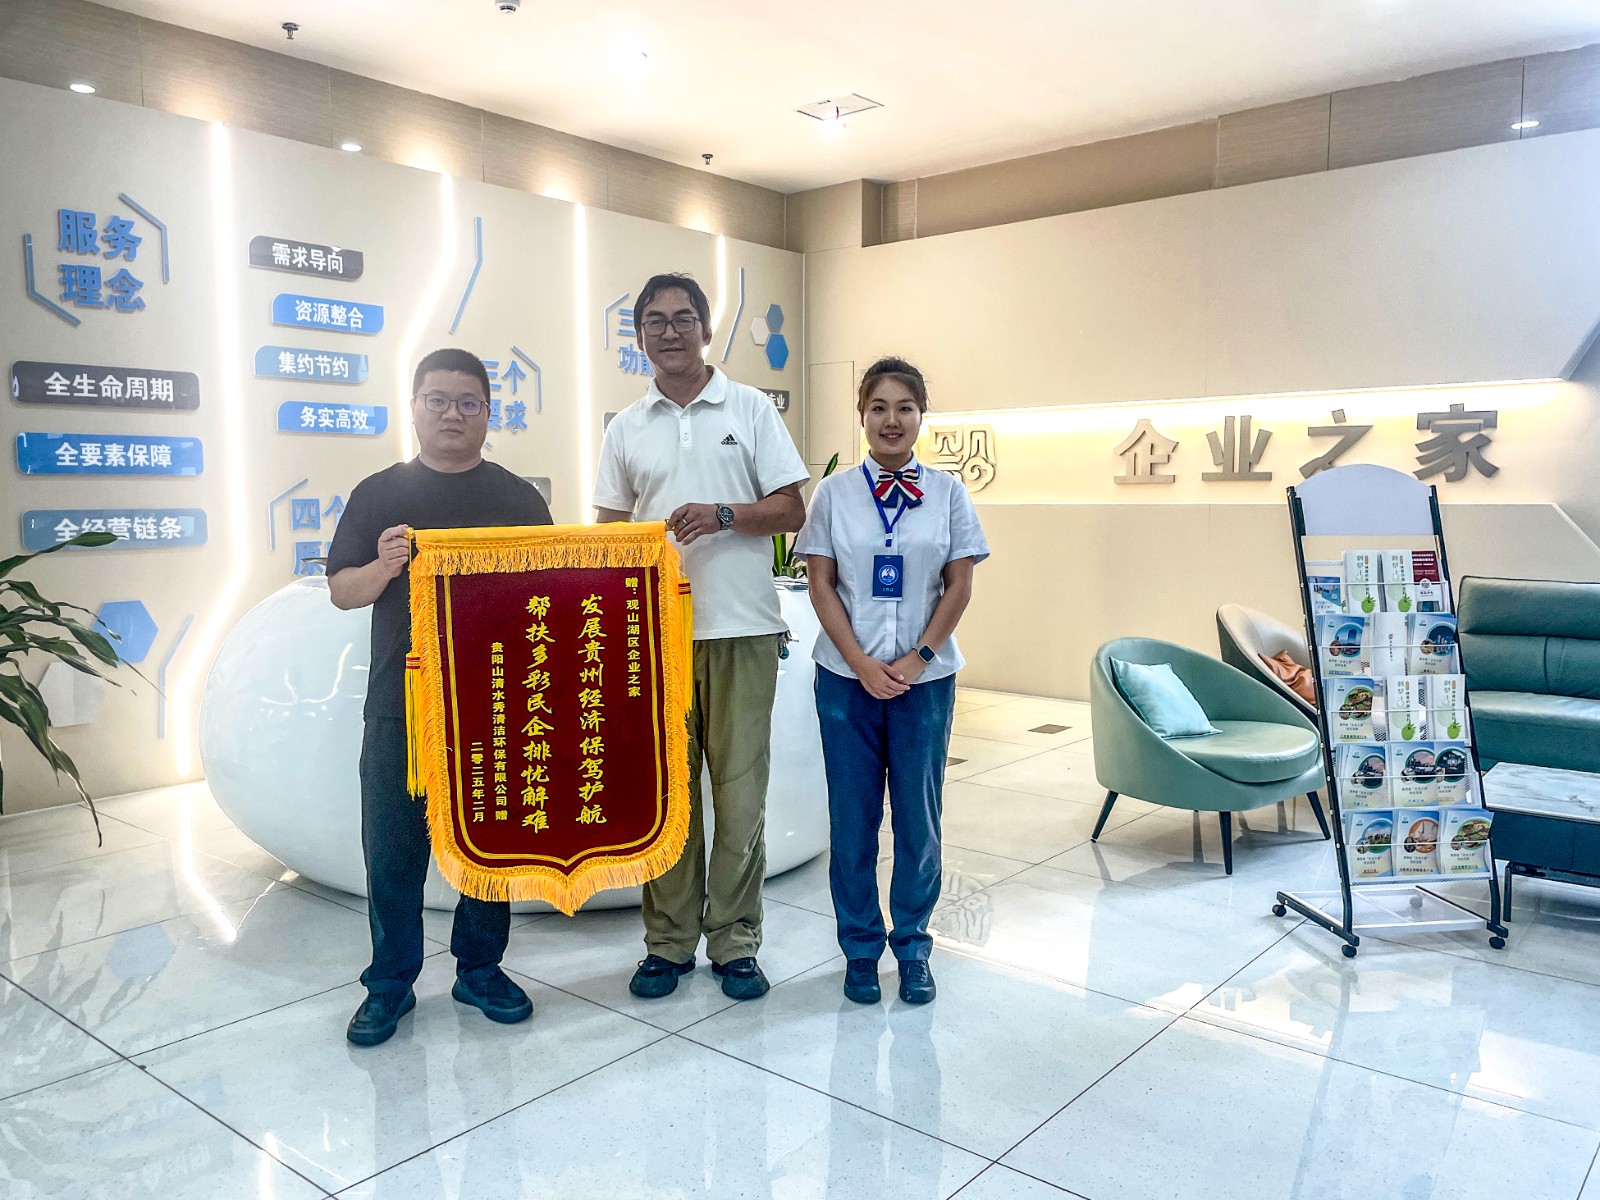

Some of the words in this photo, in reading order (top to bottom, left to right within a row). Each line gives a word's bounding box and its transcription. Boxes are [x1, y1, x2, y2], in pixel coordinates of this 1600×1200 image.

[58, 208, 143, 260] 服务
[272, 242, 344, 274] 需求导向
[59, 264, 146, 311] 理念
[295, 300, 364, 329] 资源整合
[278, 351, 349, 378] 集约节约
[44, 372, 174, 402] 全生命周期
[300, 405, 369, 431] 务实高效
[54, 442, 173, 468] 全要素保障
[1113, 402, 1500, 485] 企业之家
[53, 515, 182, 543] 全经营链条
[520, 595, 556, 834] 帮扶多彩民企排忧解难
[575, 593, 608, 825] 发展贵州经济保驾护航
[470, 741, 486, 823] 二零二五年二月
